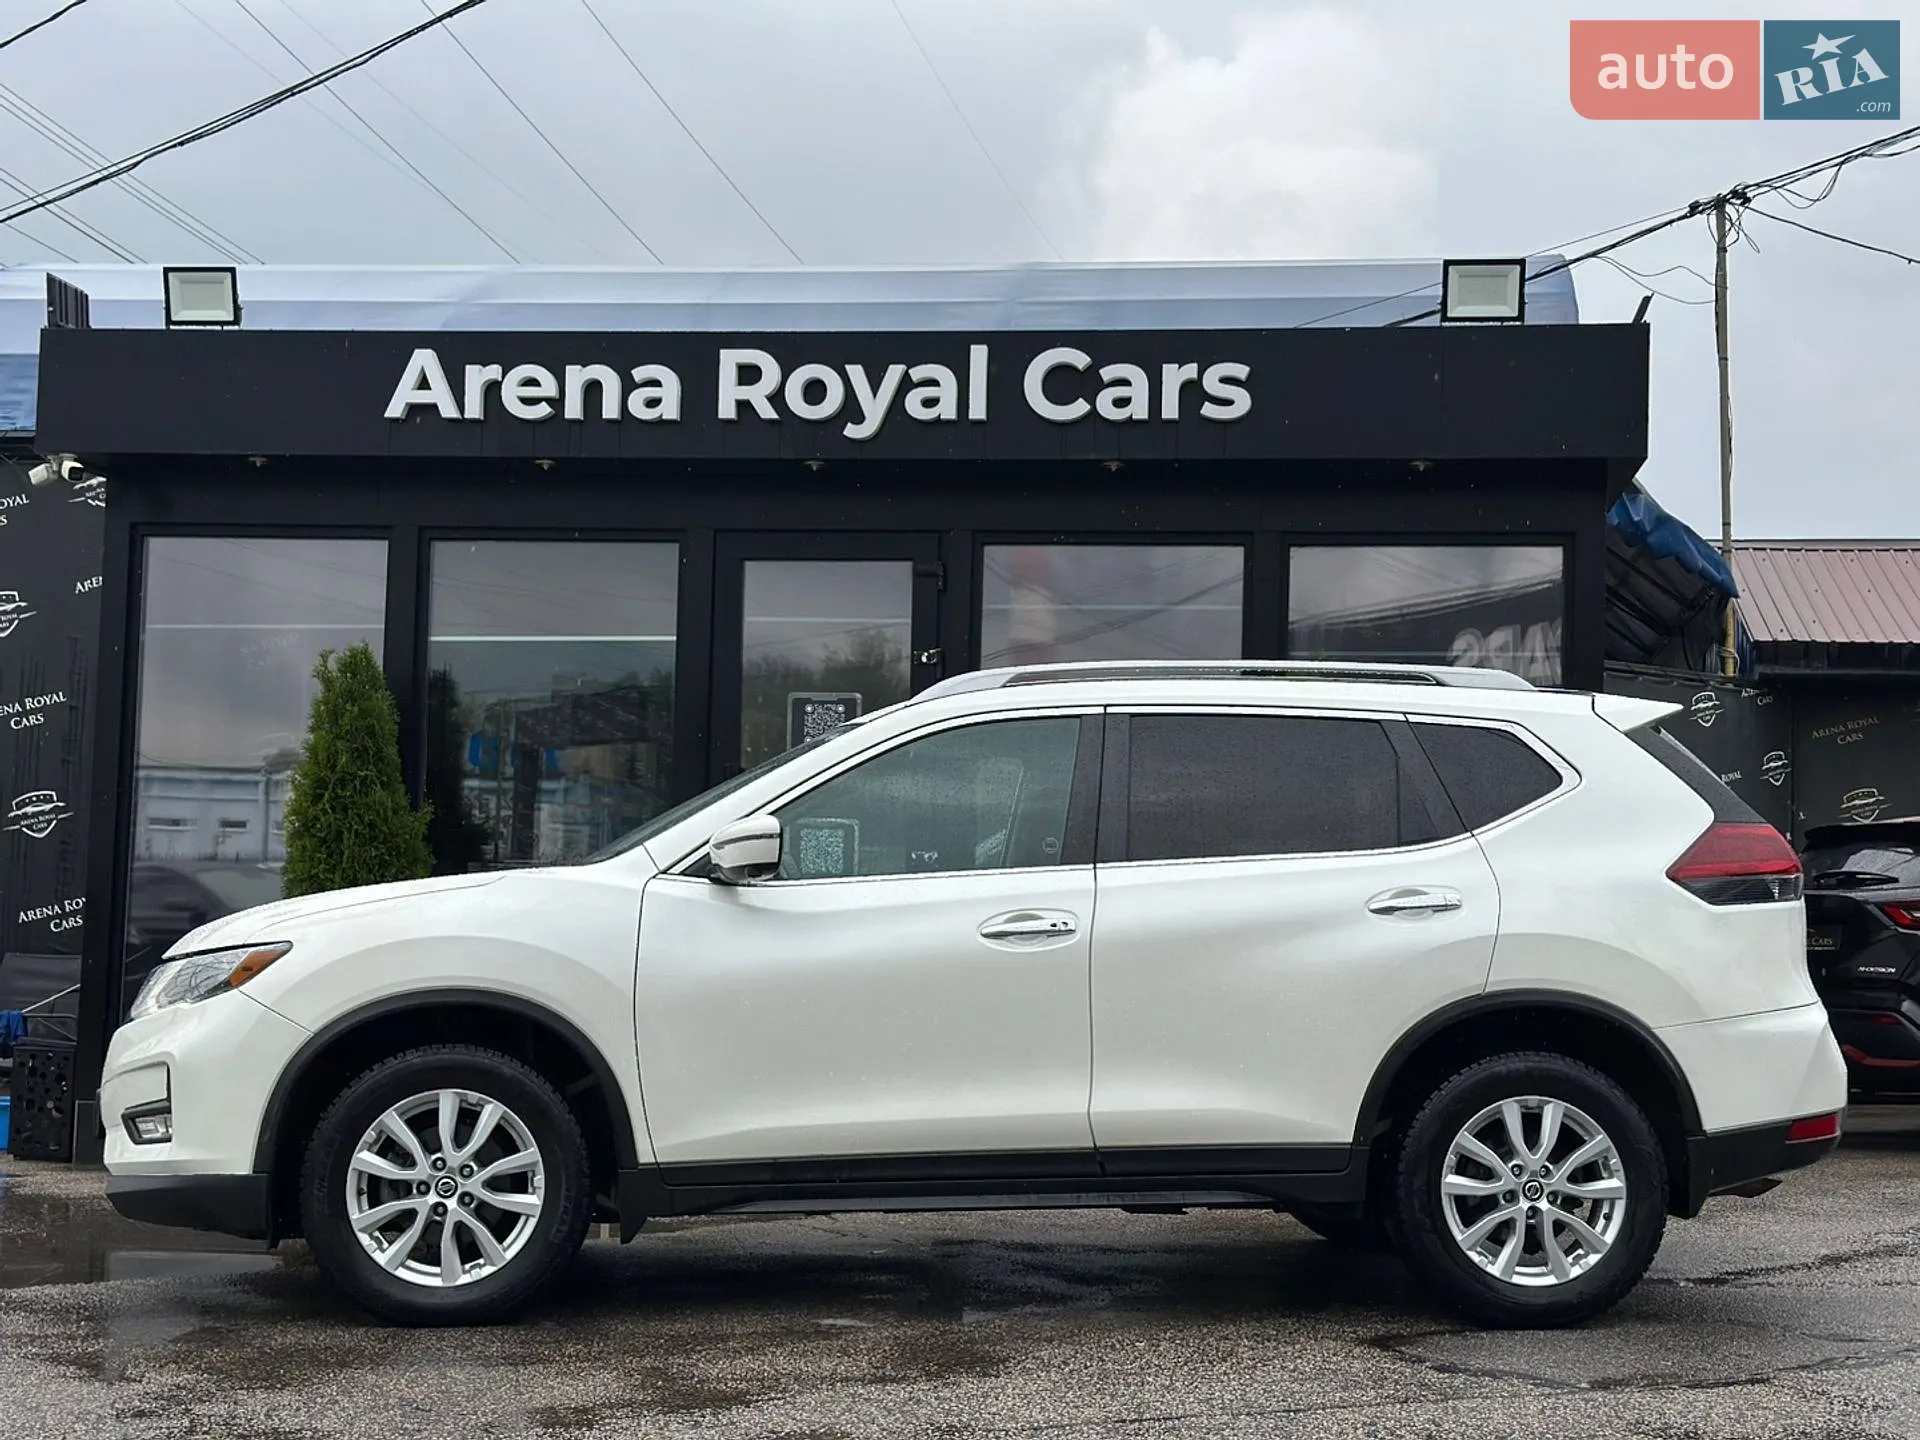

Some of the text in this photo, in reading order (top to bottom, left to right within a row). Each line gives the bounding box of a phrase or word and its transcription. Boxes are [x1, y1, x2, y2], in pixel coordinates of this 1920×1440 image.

[384, 344, 1253, 441] Arena Royal Cars
[24, 691, 68, 710] ROYAL
[10, 712, 45, 730] CARS
[1837, 732, 1865, 745] CARS
[18, 904, 62, 924] ARENA
[50, 914, 84, 933] CARS
